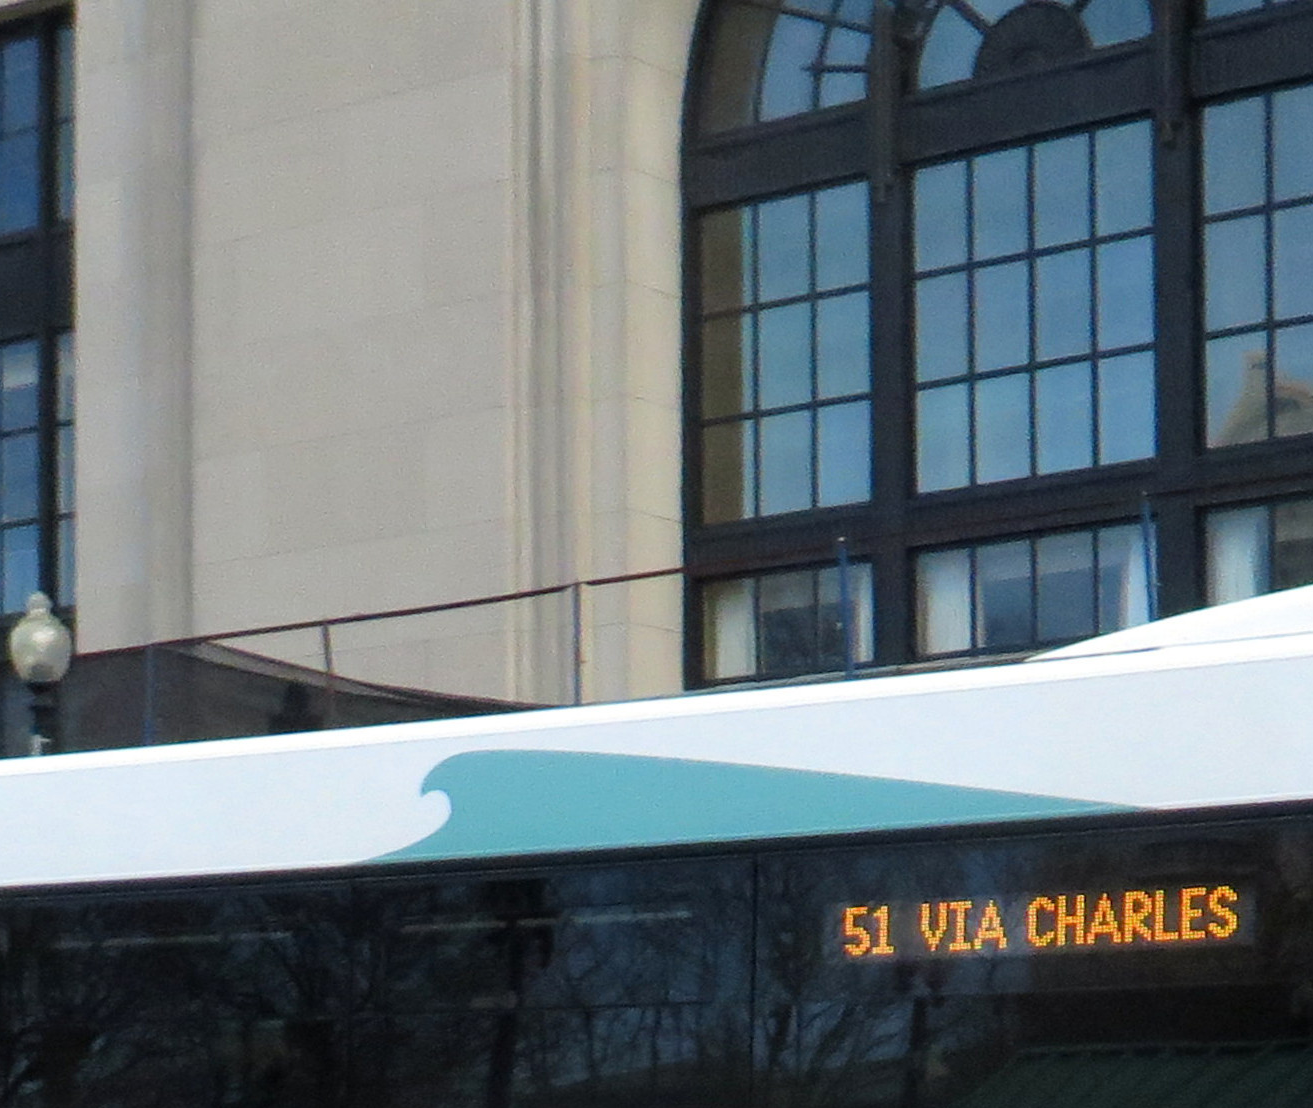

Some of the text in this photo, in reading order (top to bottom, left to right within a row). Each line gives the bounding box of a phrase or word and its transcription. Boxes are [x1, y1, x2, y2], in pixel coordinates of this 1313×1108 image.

[843, 884, 1238, 956] 51 VIA CHARLES
